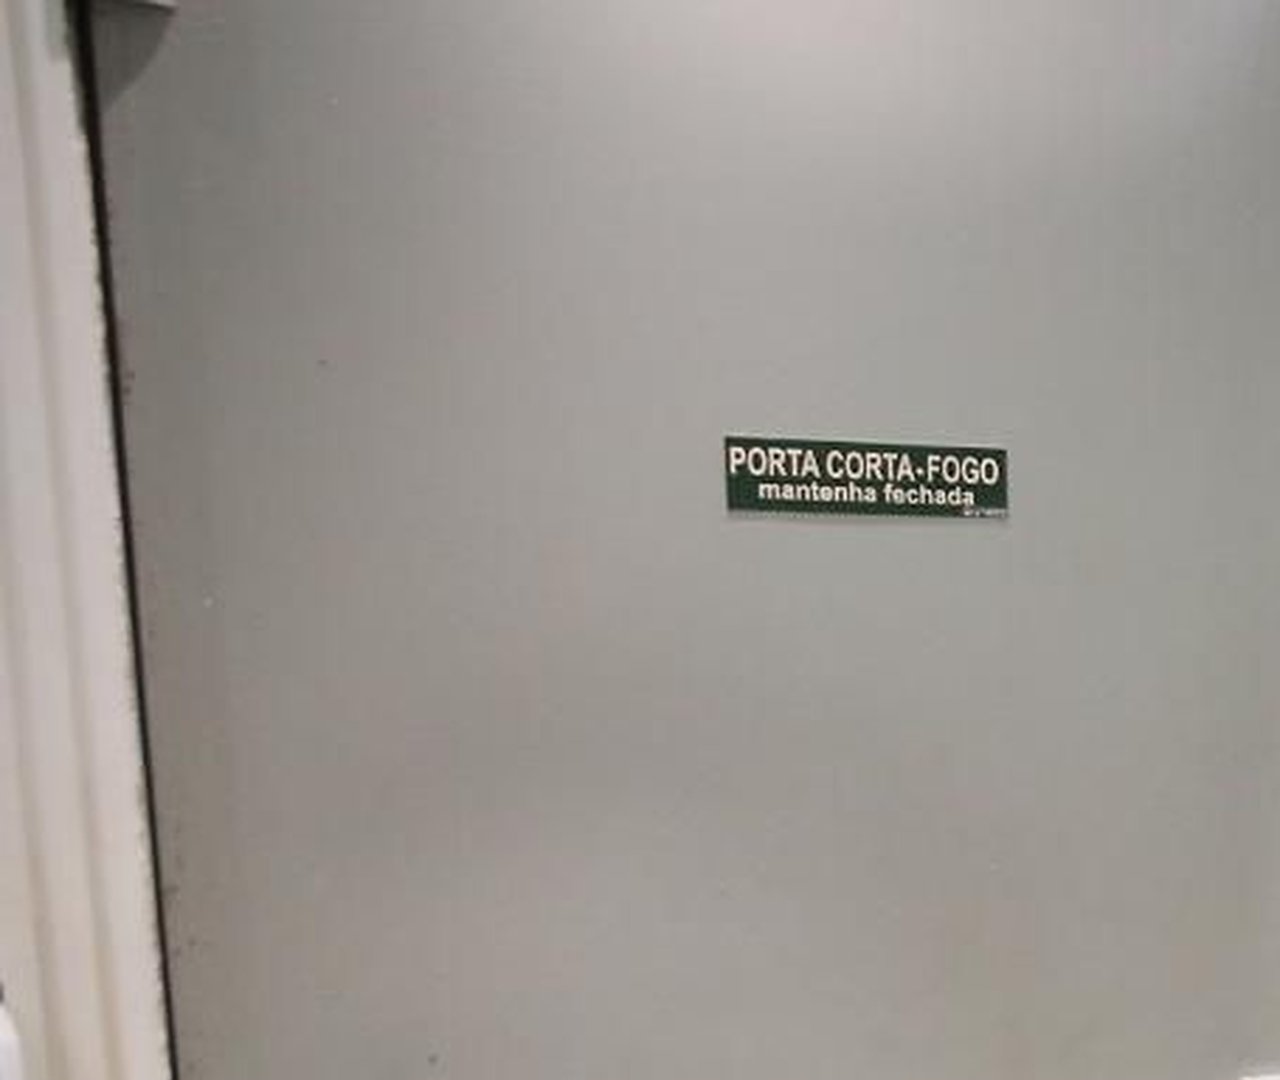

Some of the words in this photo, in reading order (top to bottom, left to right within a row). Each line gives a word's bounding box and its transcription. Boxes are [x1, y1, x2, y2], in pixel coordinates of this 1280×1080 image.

[729, 447, 820, 478] PORTA
[826, 450, 999, 485] CORTA-FOGO
[758, 482, 877, 502] mantenha
[884, 484, 974, 506] fechada
